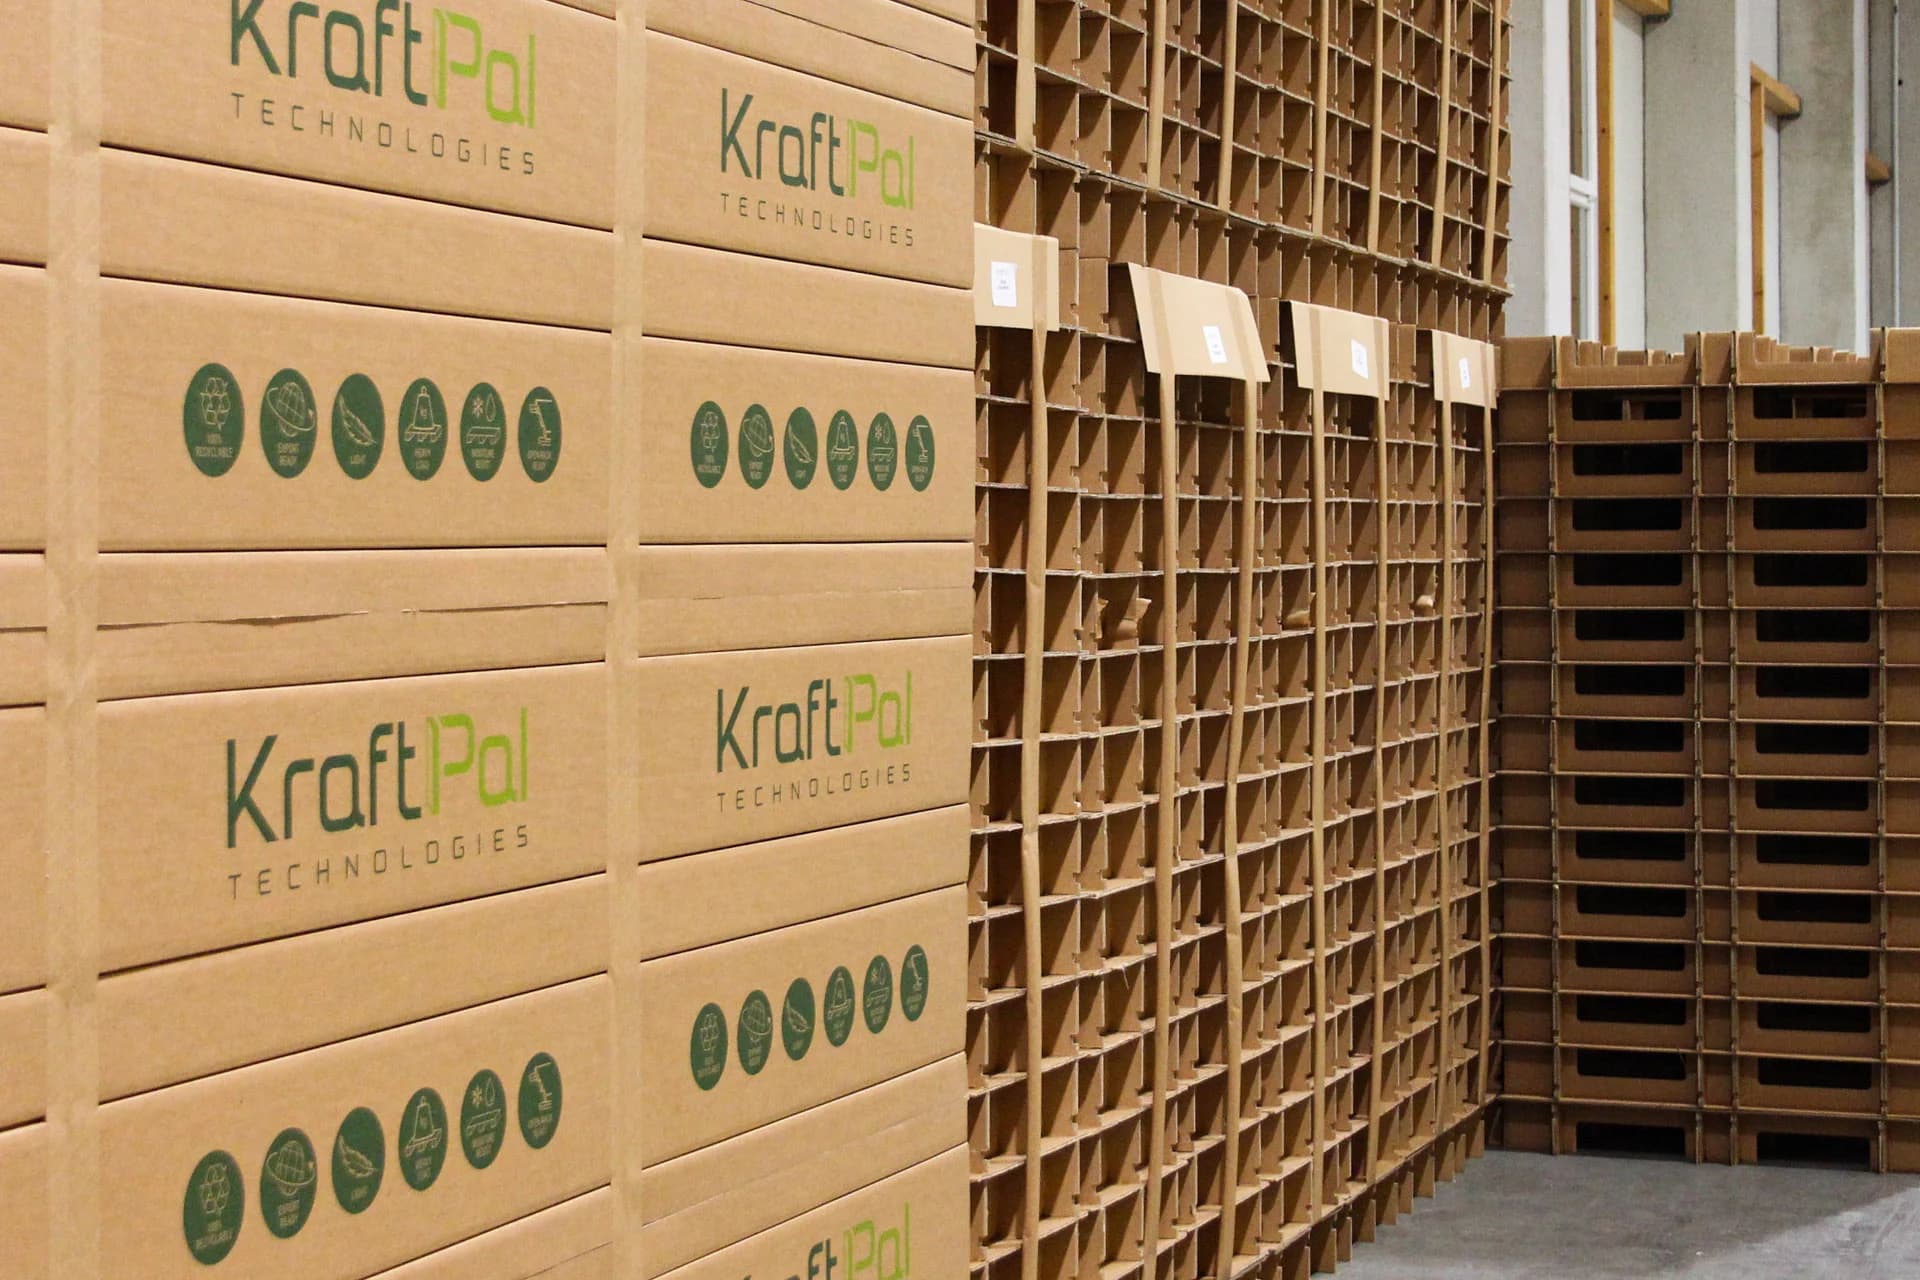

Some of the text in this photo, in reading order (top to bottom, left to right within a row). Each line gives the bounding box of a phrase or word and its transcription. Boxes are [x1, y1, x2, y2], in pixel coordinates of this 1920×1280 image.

[230, 0, 535, 129] KraftPal
[230, 91, 535, 176] TECHNOLOGIES
[720, 87, 914, 210] KraftPal
[720, 192, 914, 247] TECHNOLOGIES
[717, 671, 912, 774] KraftPal
[224, 707, 528, 850] KraftPal
[717, 763, 911, 813] TECHNOLOGIES
[227, 824, 529, 900] TECHNOLOGIES
